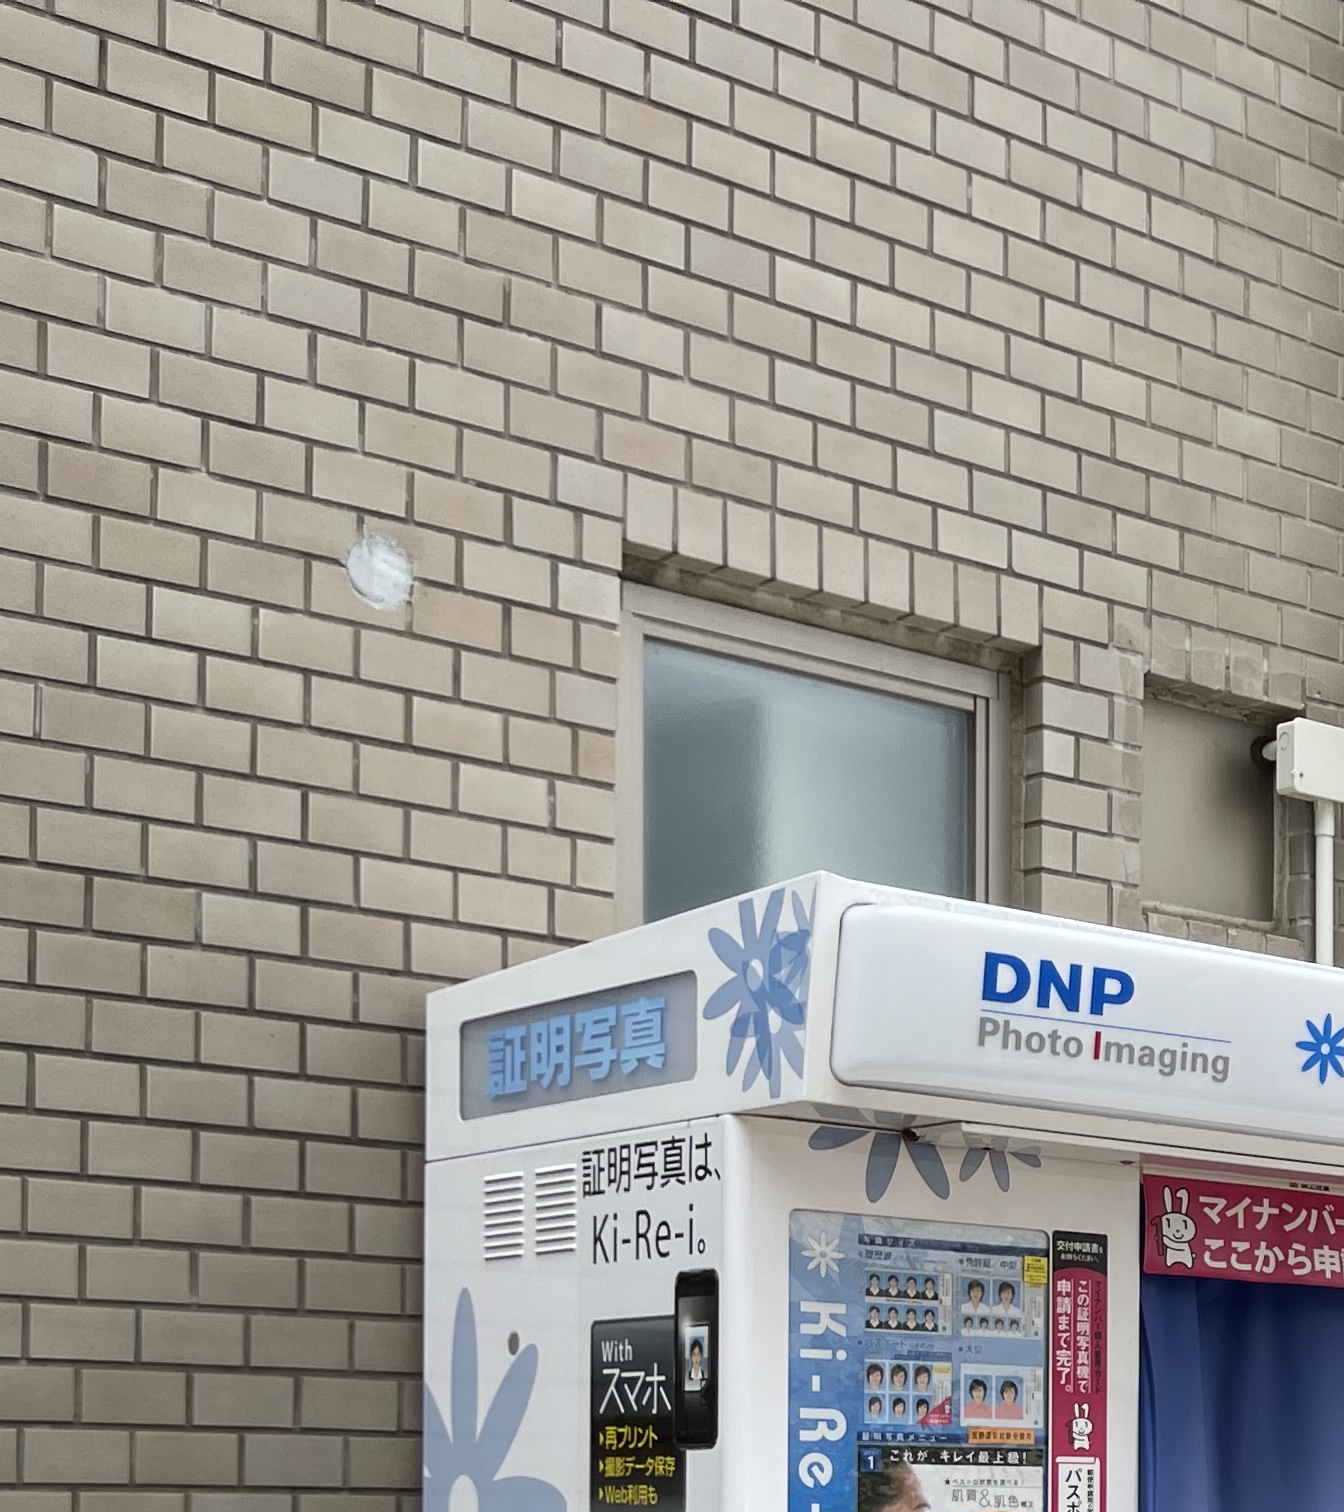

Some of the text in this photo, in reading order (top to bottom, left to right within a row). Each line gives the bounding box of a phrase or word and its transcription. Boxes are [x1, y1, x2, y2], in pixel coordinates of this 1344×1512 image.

[981, 951, 1135, 1017] DNP
[487, 997, 667, 1100] 証明写真
[977, 1017, 1231, 1082] Photo Imaging
[581, 1133, 721, 1199] 証明写真は、
[601, 1338, 633, 1363] With
[1077, 1280, 1090, 1393] この証明写真機で
[599, 1363, 672, 1415] スマホ
[604, 1426, 658, 1450] 再プリント
[867, 1456, 874, 1469] 1
[604, 1456, 676, 1478] 撮影データ保存
[604, 1484, 658, 1505] Web利用も
